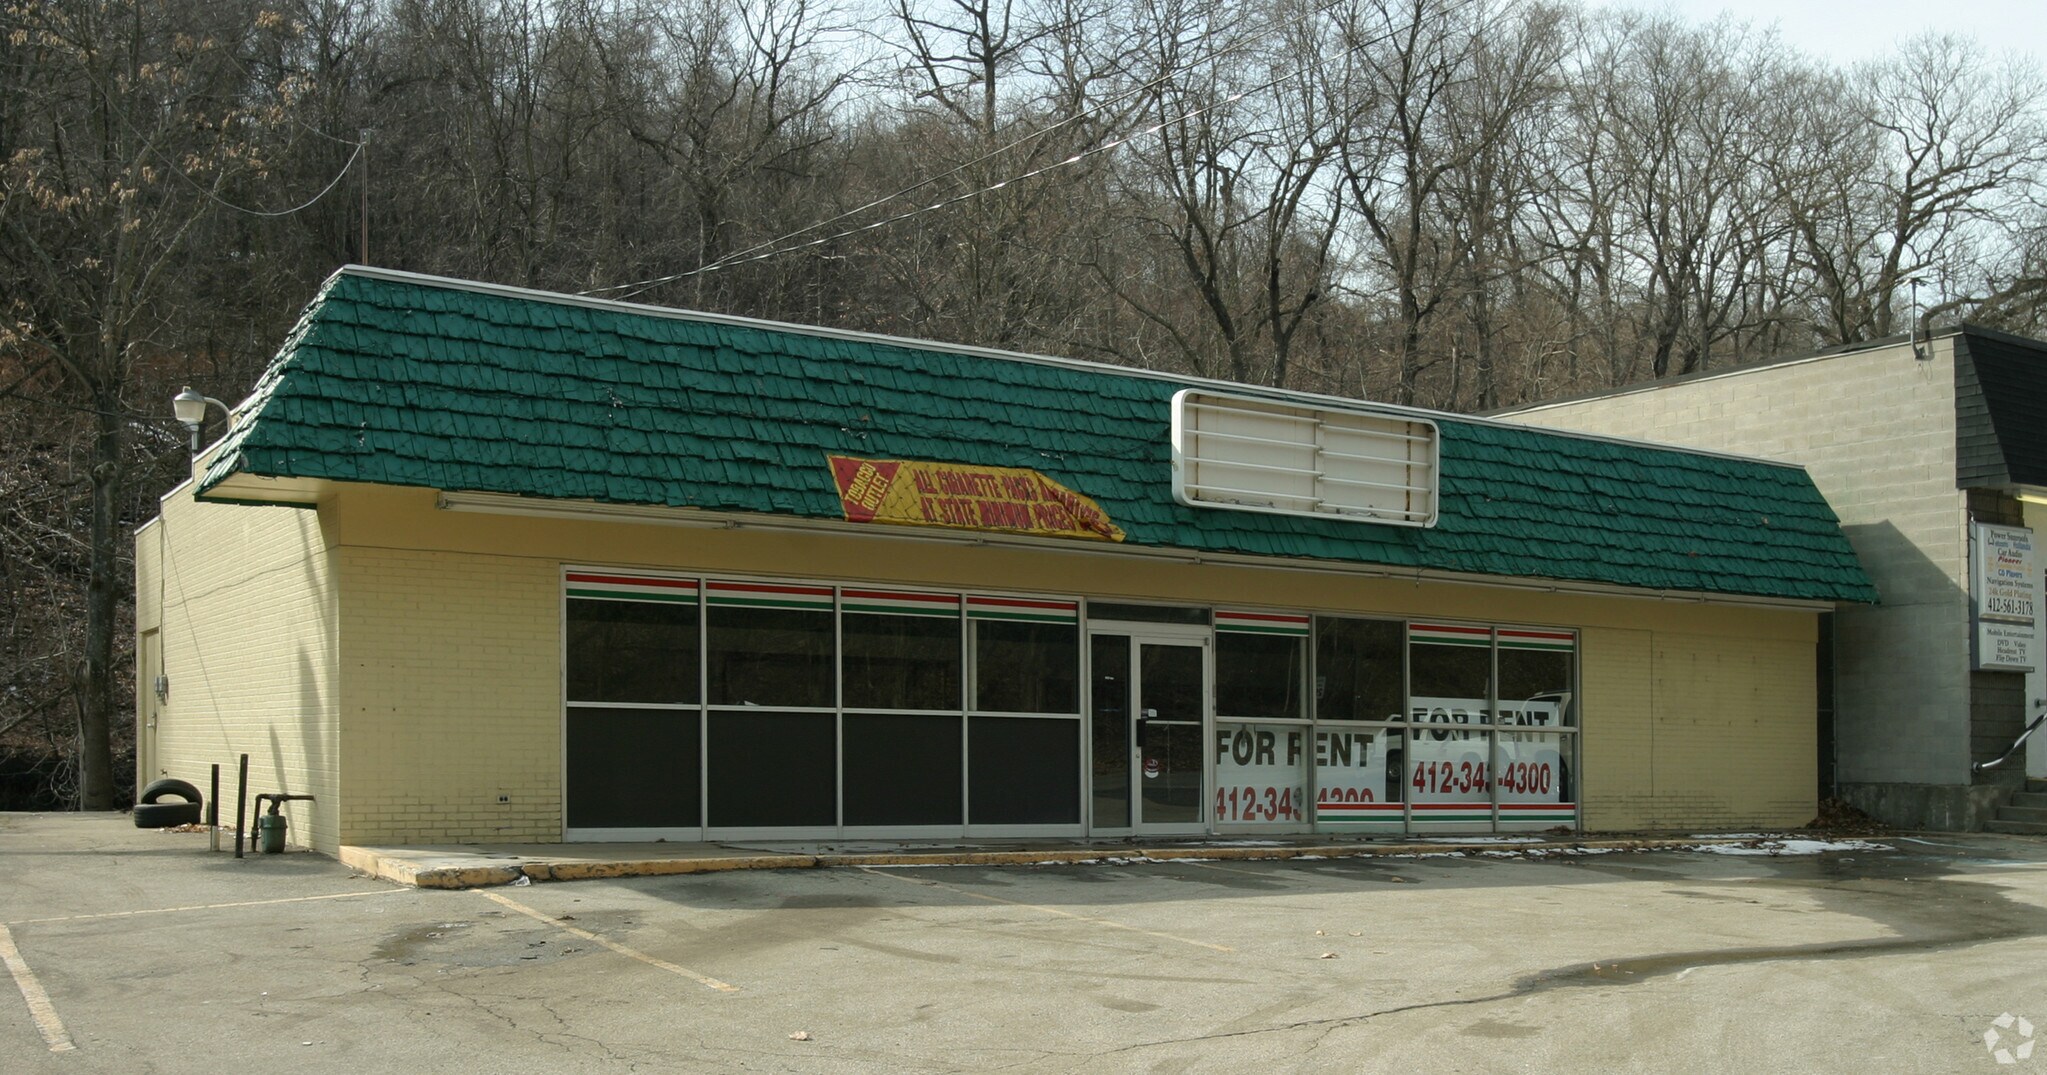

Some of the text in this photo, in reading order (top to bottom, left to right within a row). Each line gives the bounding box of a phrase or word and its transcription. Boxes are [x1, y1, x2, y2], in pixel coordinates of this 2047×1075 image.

[845, 462, 876, 504] TOBACCO
[862, 474, 889, 510] OUTLET
[915, 470, 938, 494] ALL
[938, 471, 999, 497] CIGARETTE
[939, 499, 979, 524] STATE
[1990, 530, 2006, 540] Power
[1998, 548, 2022, 558] Car Audio
[1998, 556, 2022, 564] Pioneer
[1986, 577, 2034, 589] Navigation Systems
[1999, 589, 2013, 597] Gold
[1988, 598, 2034, 616] 412-561-3178
[1413, 707, 1469, 741] FOR
[1216, 730, 1374, 767] FOR RENT
